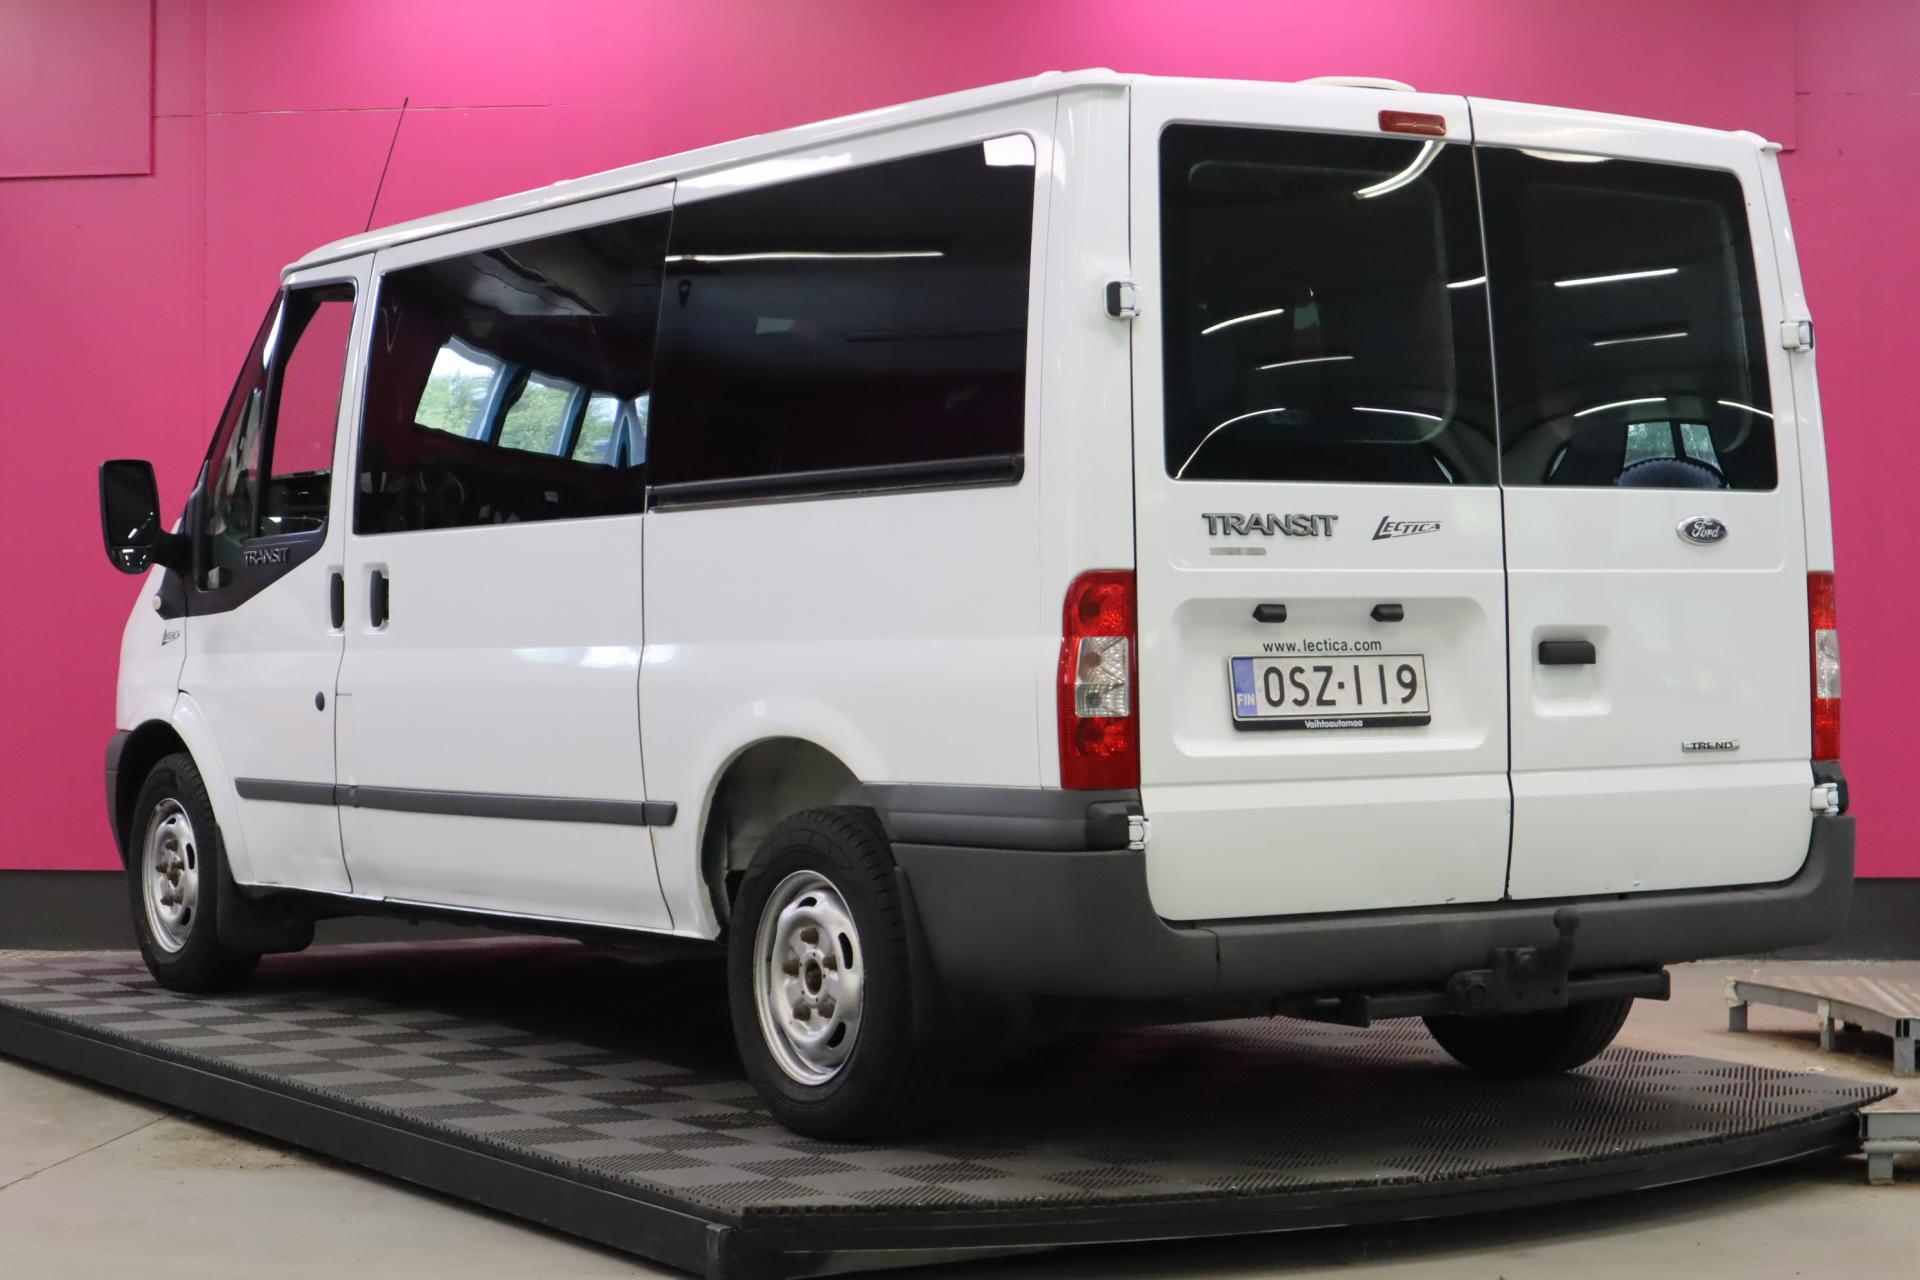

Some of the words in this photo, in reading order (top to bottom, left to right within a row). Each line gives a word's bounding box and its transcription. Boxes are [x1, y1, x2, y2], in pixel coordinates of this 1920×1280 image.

[1202, 513, 1338, 537] TRANSIT
[1371, 515, 1442, 540] LECTICA
[1691, 520, 1720, 538] Ford
[244, 547, 289, 566] TRANSIT
[1263, 638, 1382, 653] www.lectica.com
[1236, 693, 1256, 706] FIN
[1304, 719, 1363, 729] Vaihtoautomaa
[1691, 741, 1734, 750] TREND
